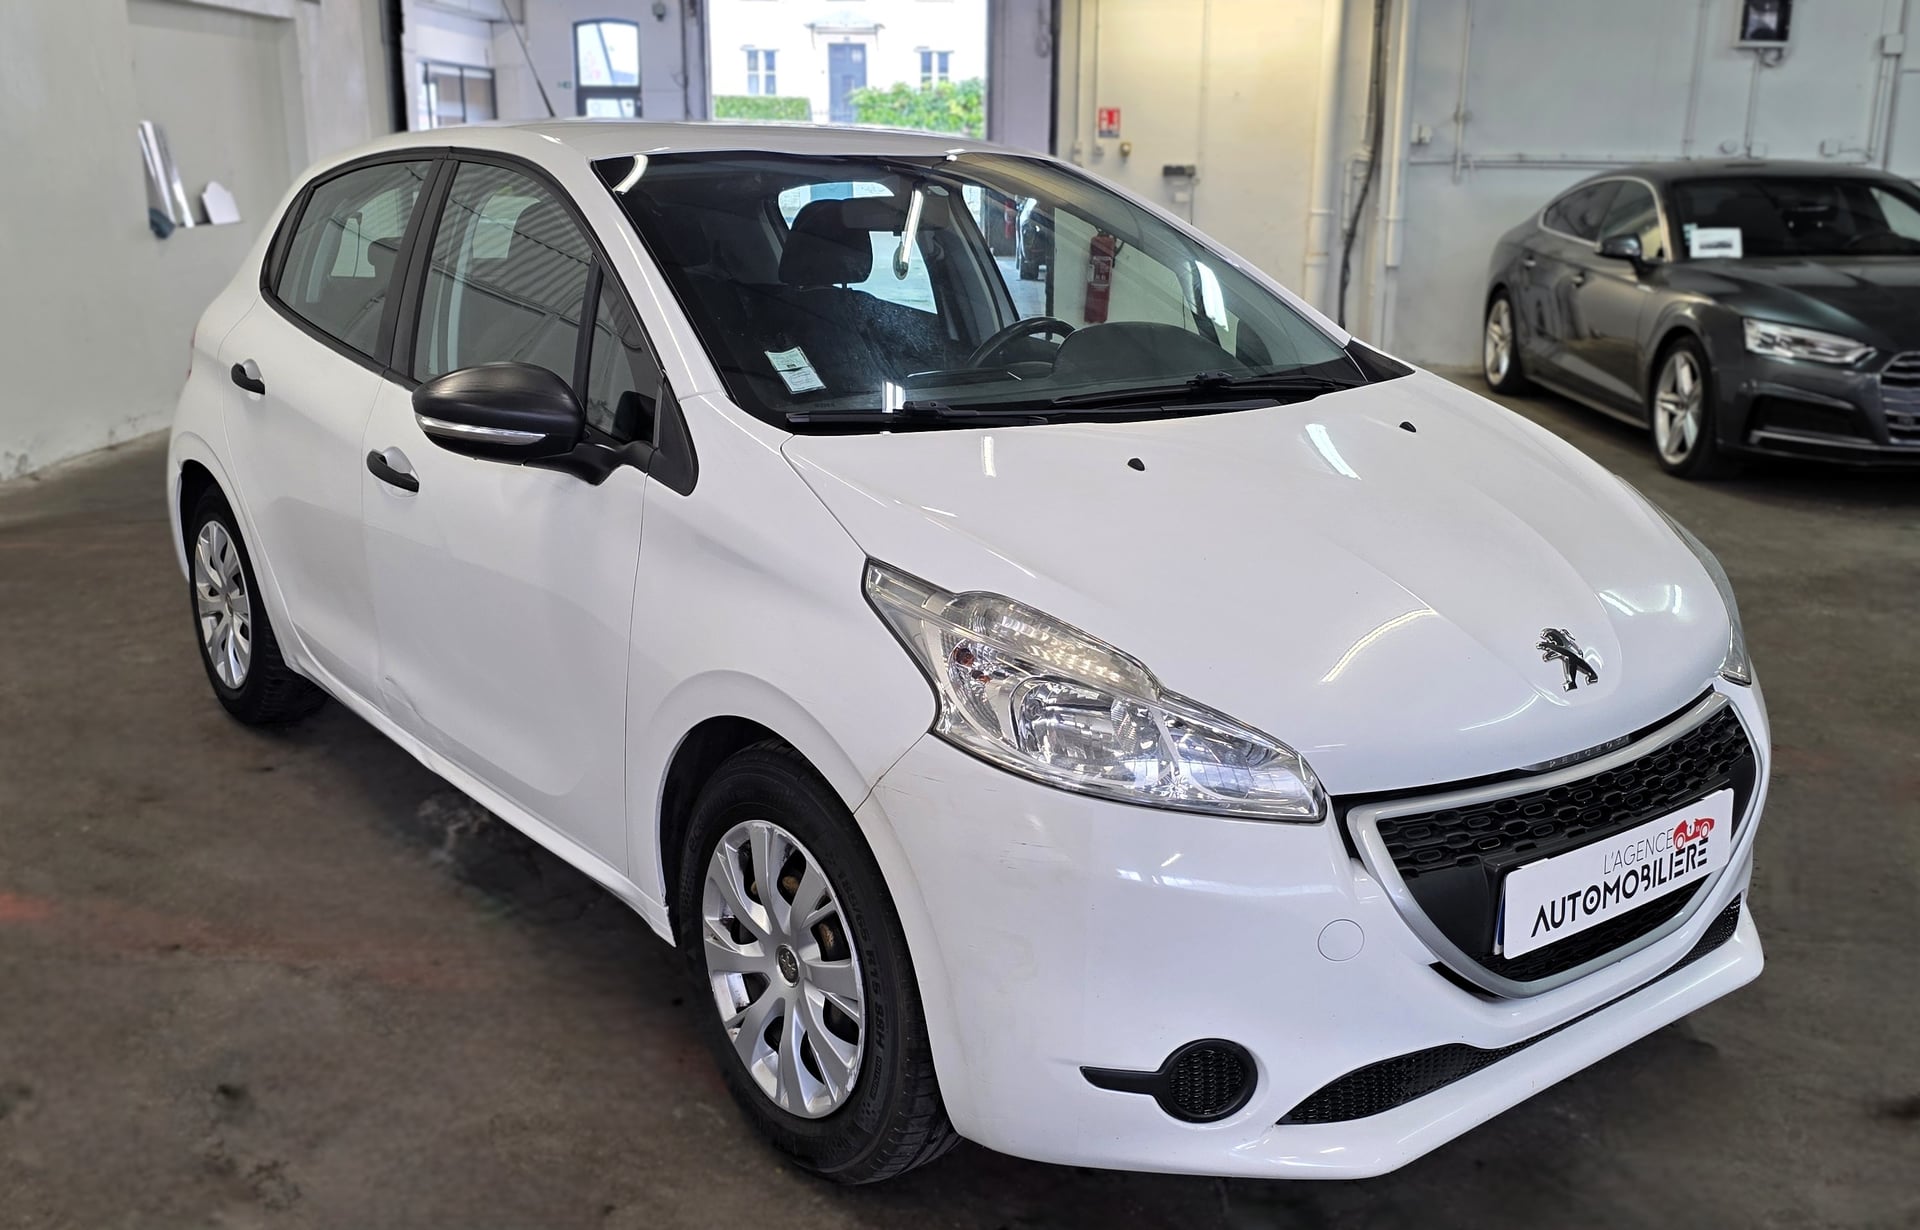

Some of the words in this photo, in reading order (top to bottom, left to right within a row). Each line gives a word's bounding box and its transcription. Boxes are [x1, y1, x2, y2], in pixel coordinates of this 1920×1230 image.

[1603, 828, 1674, 875] L'AGENCE
[866, 948, 884, 996] R15
[873, 1000, 888, 1051] 88H
